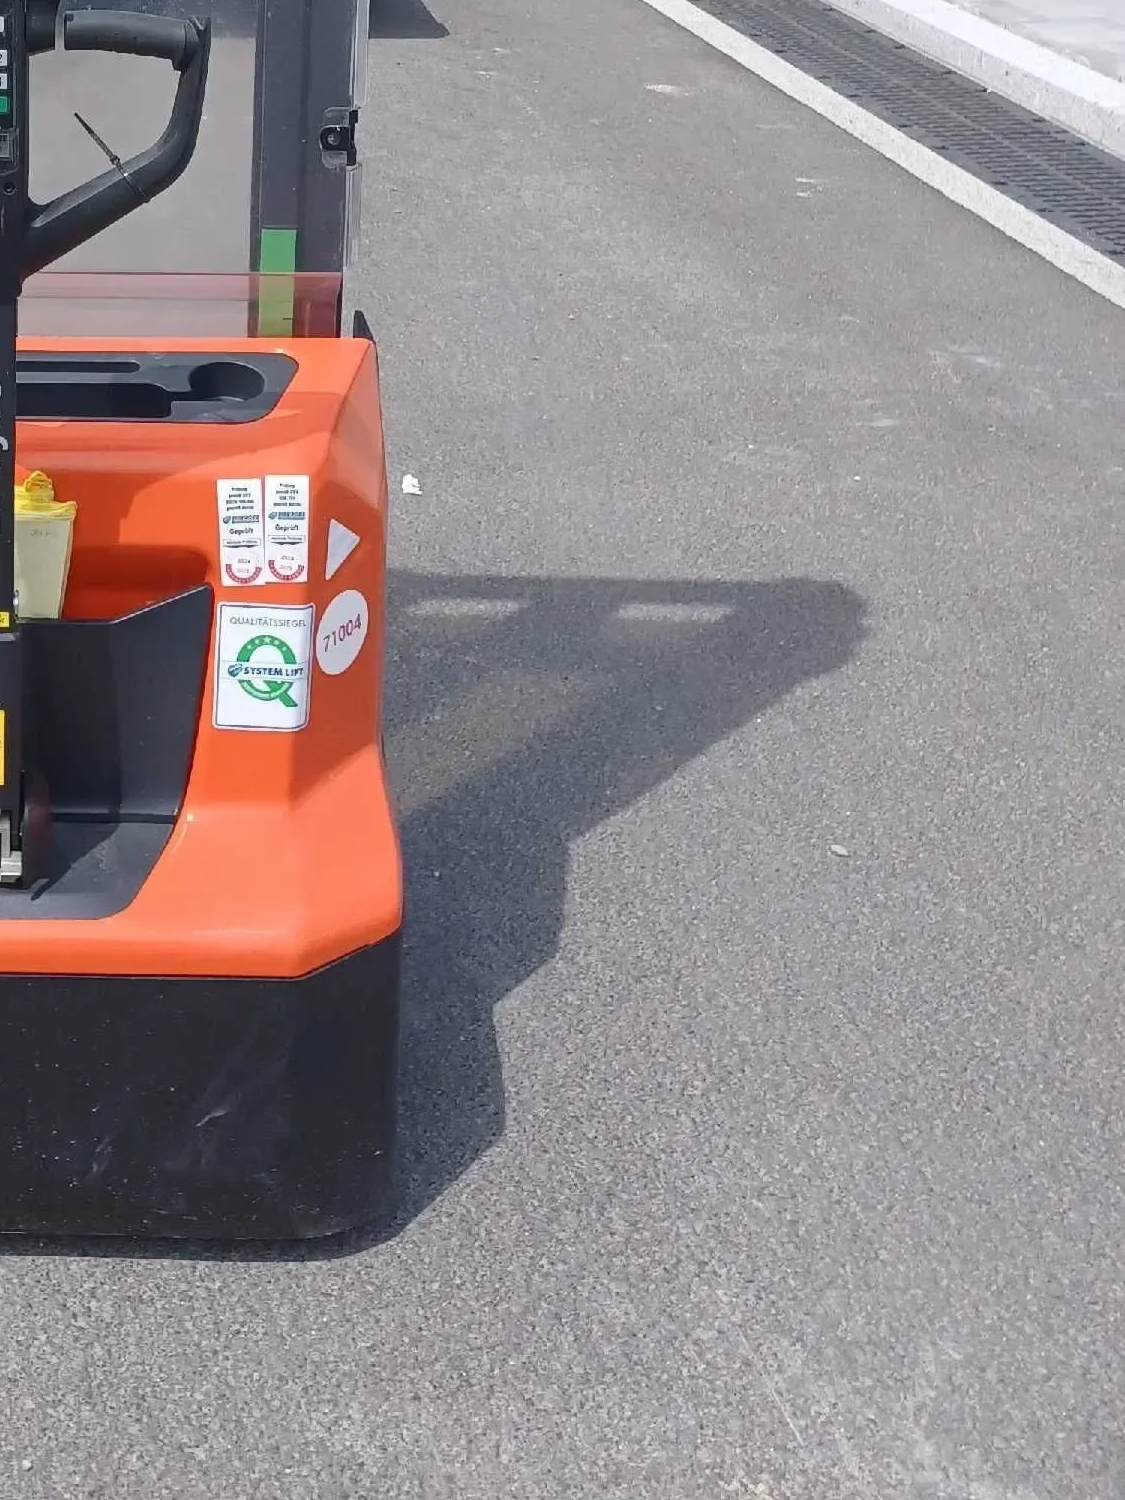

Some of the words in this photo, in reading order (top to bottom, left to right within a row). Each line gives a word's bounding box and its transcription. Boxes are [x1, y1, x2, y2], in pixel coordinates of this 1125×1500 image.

[229, 616, 307, 628] QUALITÄTSSIEGEL
[322, 613, 362, 653] 71004
[243, 666, 284, 677] SYSTEM
[285, 667, 304, 677] LIFT
